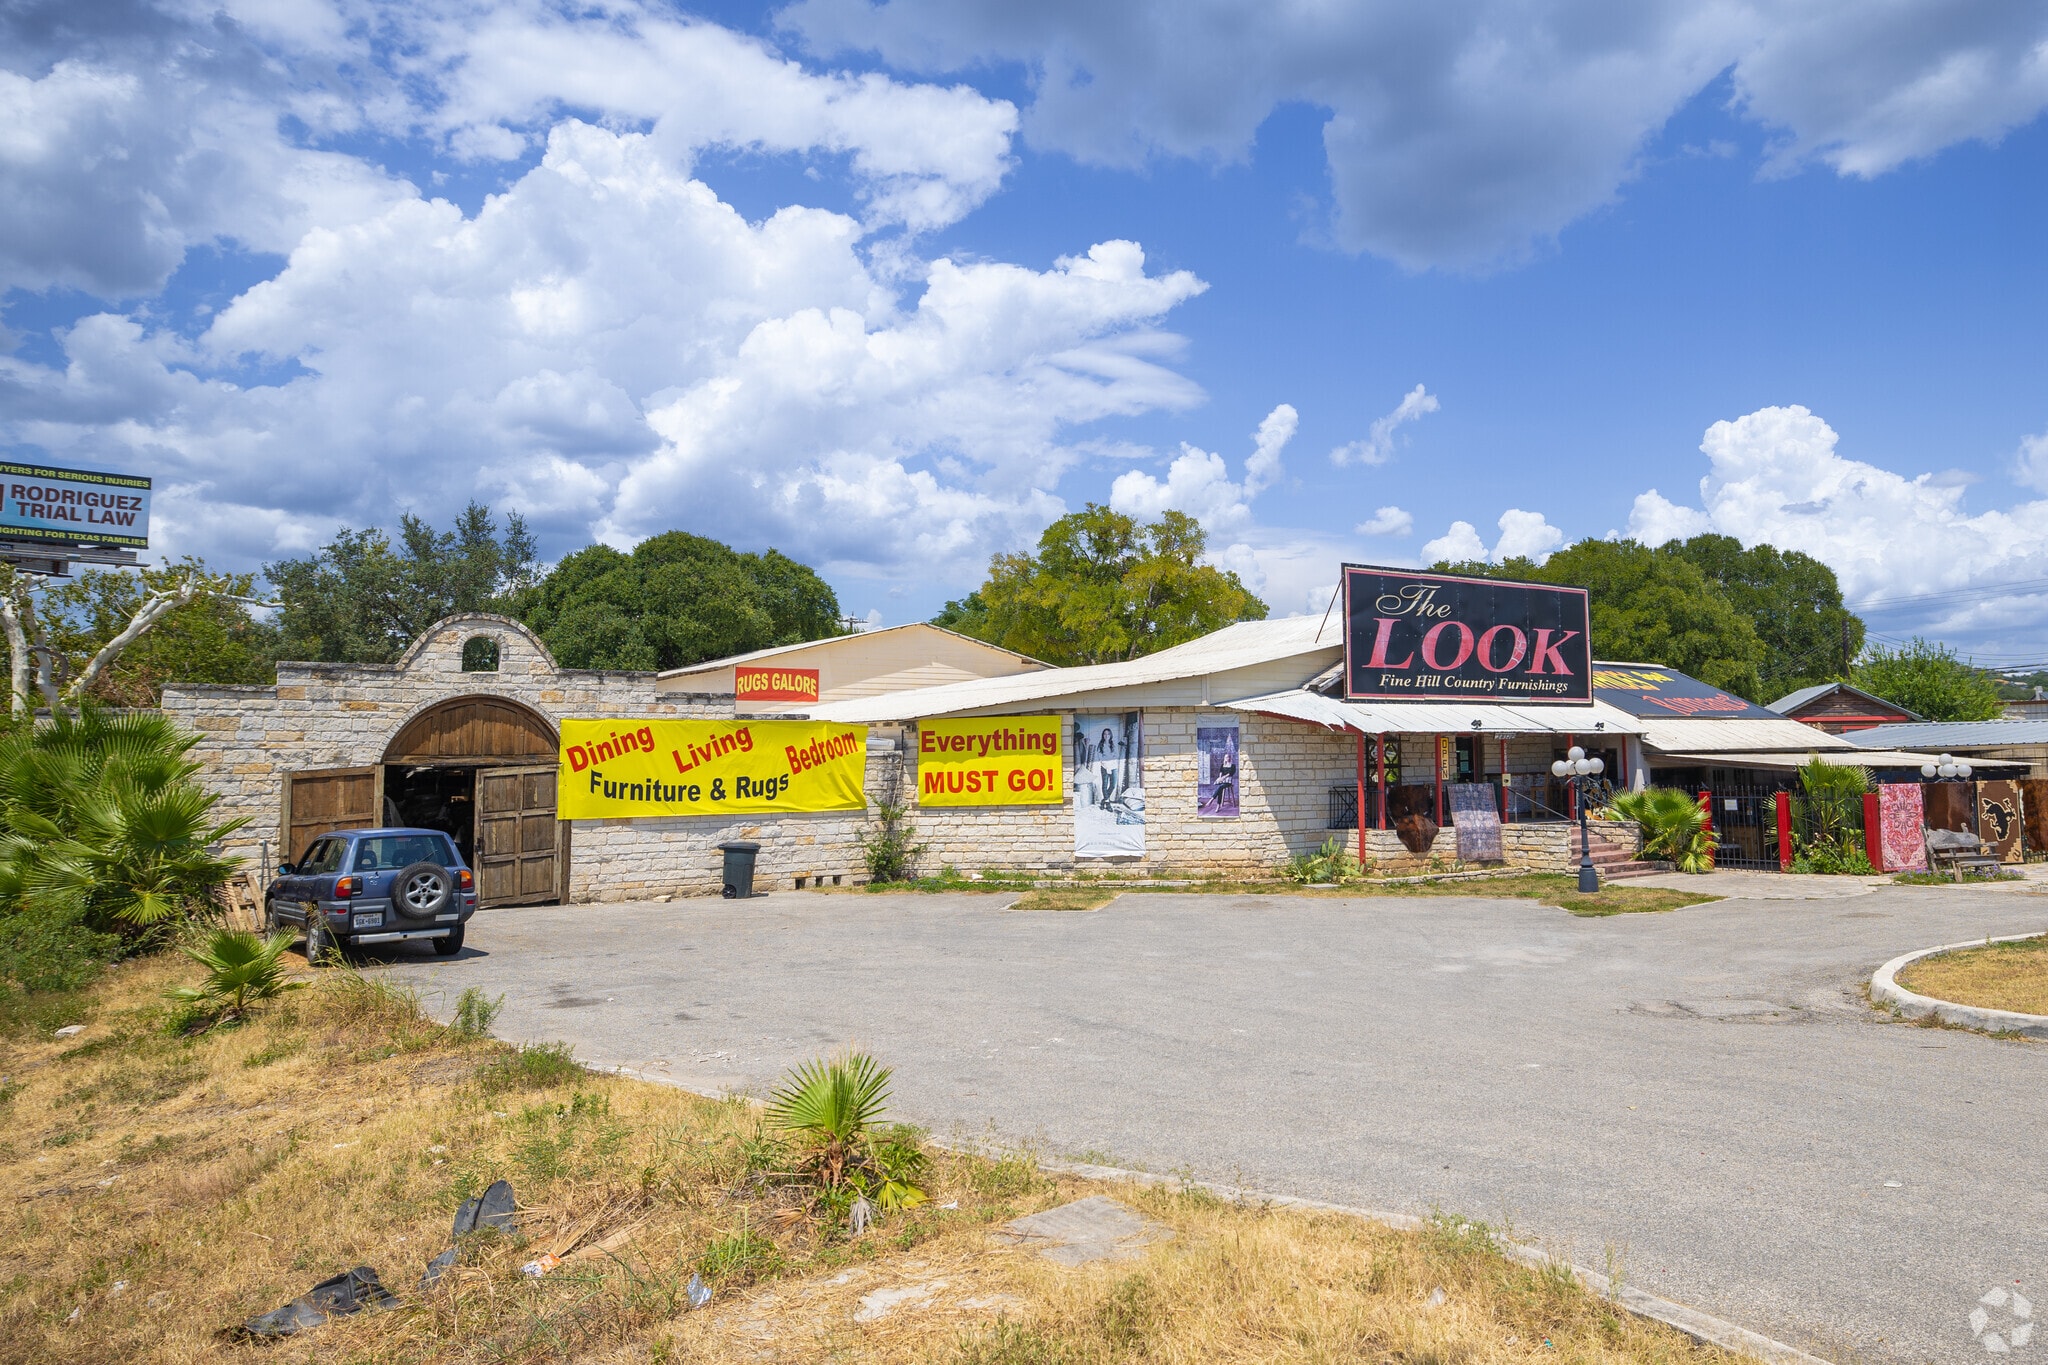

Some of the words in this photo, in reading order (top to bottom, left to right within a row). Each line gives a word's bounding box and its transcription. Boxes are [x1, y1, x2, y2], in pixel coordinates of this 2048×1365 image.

[34, 468, 56, 478] FOR
[58, 472, 103, 483] SERIOUS
[105, 476, 149, 488] INJURIES
[11, 484, 142, 511] RODRIGUEZ
[16, 501, 82, 522] TRIAL
[88, 508, 136, 527] LAW
[45, 530, 66, 540] FOR
[68, 532, 100, 542] TEXAS
[102, 535, 147, 546] FAMILIES
[1375, 584, 1452, 619] The
[1361, 617, 1581, 677] LOOK
[736, 672, 769, 696] RUGS
[771, 672, 817, 697] GALORE
[1379, 674, 1411, 687] Fine
[1414, 674, 1440, 688] Hill
[1444, 675, 1495, 690] Country
[1498, 678, 1568, 693] Furnishings
[565, 726, 656, 773] Dining
[672, 726, 755, 775] Living
[785, 730, 859, 776] Bedroom
[920, 727, 1057, 758] Everything
[589, 769, 701, 803] Furniture
[709, 777, 727, 801] &
[735, 772, 790, 801] Rugs
[924, 770, 999, 795] MUST
[1007, 767, 1054, 793] GO!
